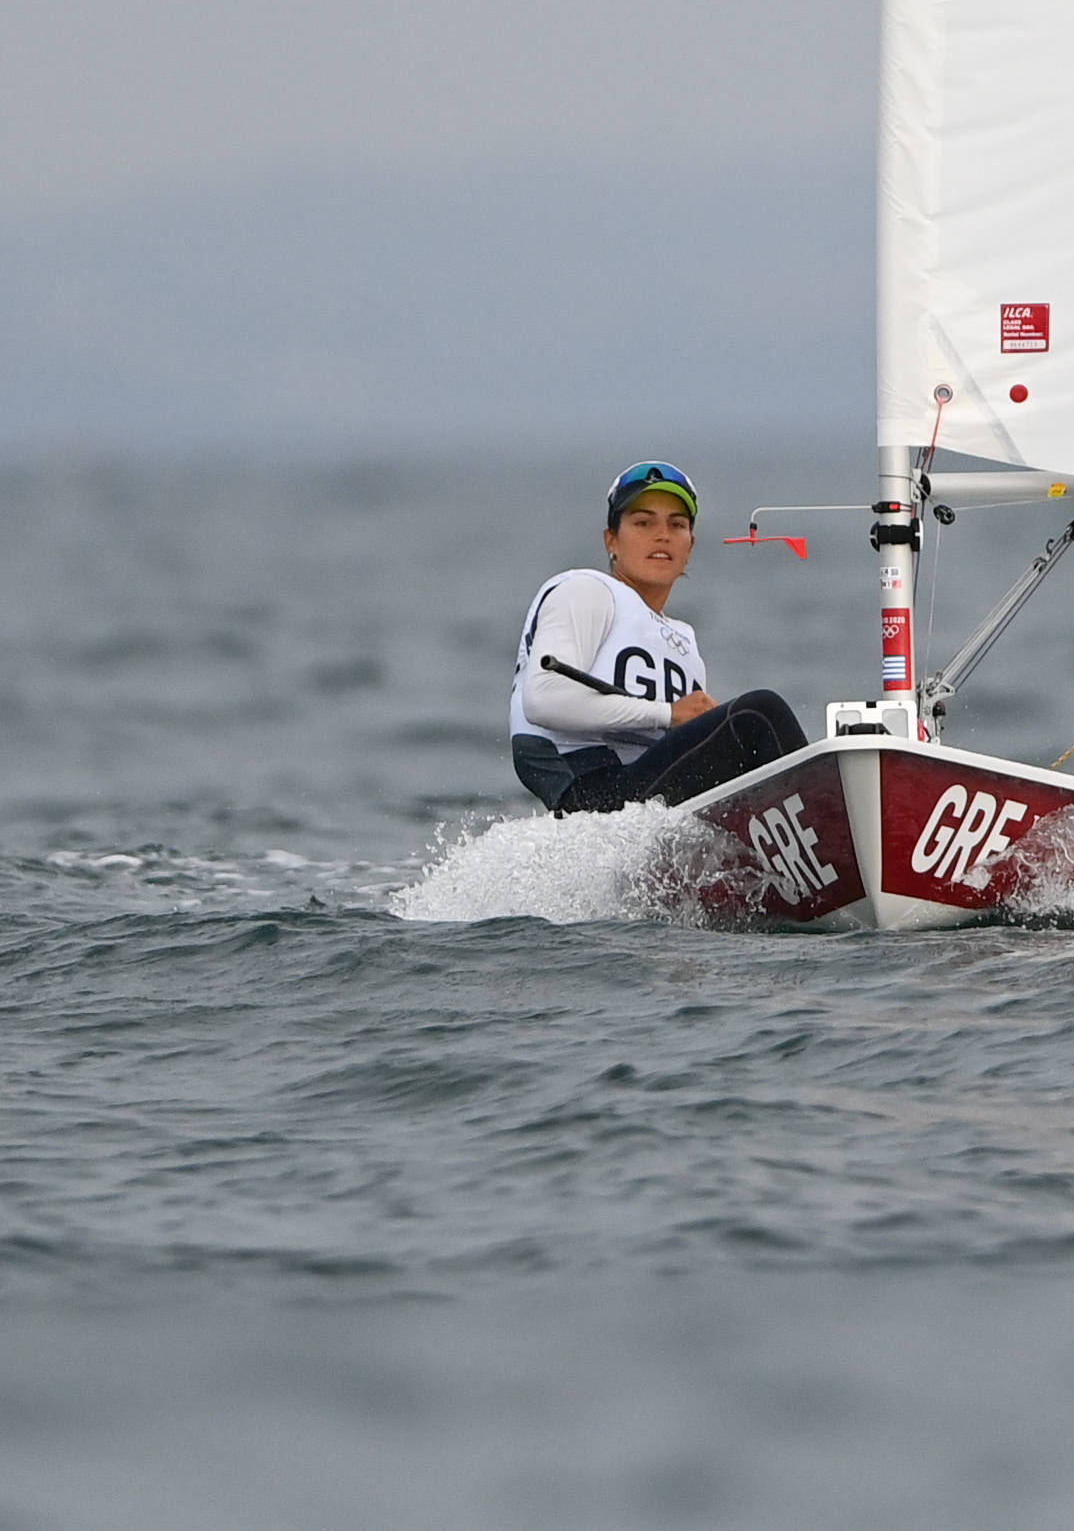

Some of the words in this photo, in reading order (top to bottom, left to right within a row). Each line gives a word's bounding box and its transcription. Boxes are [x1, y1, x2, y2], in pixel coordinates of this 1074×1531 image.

[1003, 307, 1032, 318] ILCA
[614, 646, 703, 702] GR
[748, 793, 838, 906] GRE
[911, 784, 1028, 890] GRE
